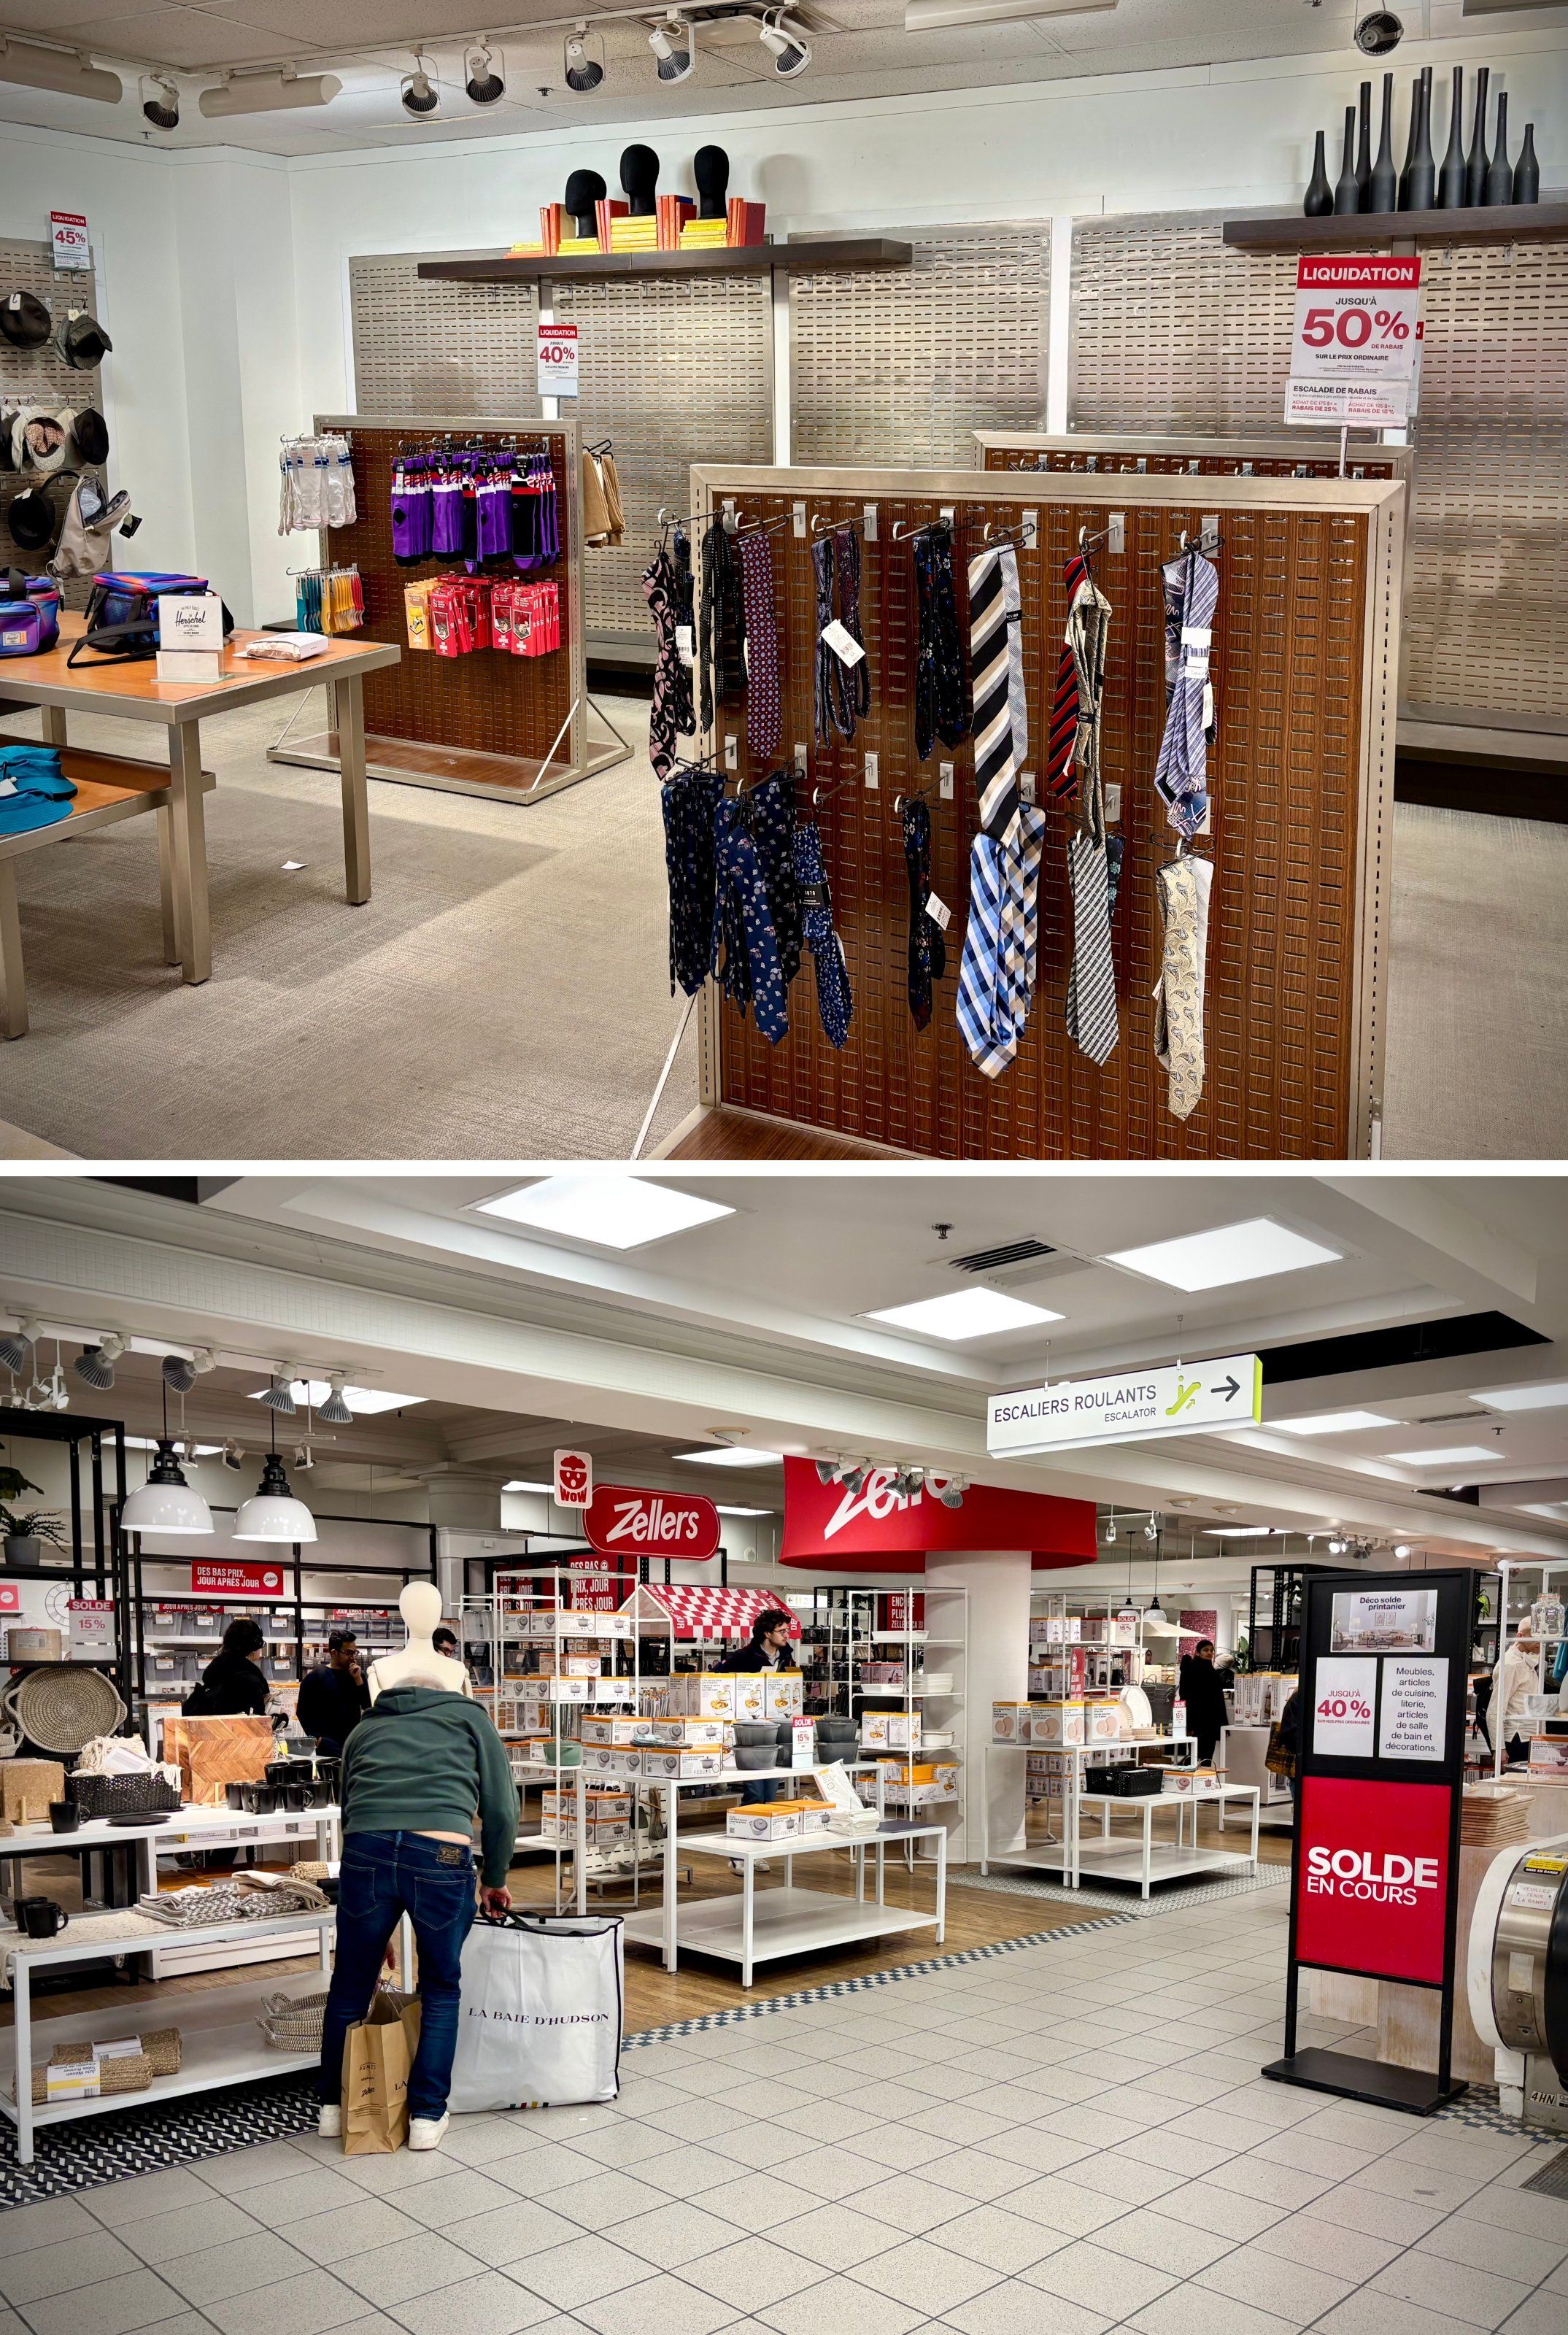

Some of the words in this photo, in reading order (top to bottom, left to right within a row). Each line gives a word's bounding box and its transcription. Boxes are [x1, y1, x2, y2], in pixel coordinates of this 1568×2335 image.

[53, 215, 85, 224] LIQUIDATION
[55, 230, 86, 244] 45%
[1303, 267, 1413, 281] LIQUIDATION
[1335, 296, 1378, 306] JUSQU'À
[1302, 308, 1410, 348] 50%
[539, 346, 575, 363] 40%
[1294, 385, 1335, 393] ESCALADE
[175, 610, 206, 628] Herschel
[995, 1397, 1070, 1423] ESCALIERS
[1075, 1385, 1156, 1411] ROULANTS
[1105, 1407, 1156, 1422] ESCALATOR
[560, 1483, 587, 1503] WOW
[606, 1499, 700, 1543] Zellers
[197, 1567, 211, 1575] DES
[212, 1567, 226, 1577] BAS
[228, 1569, 246, 1578] PRIX,
[197, 1577, 216, 1586] JOUR
[242, 1578, 259, 1588] JOUR
[590, 1578, 609, 1592] JOUR
[72, 1601, 111, 1610] SOLDE
[594, 1596, 614, 1610] JOUR
[1368, 1603, 1406, 1611] printanier
[79, 1619, 92, 1629] 15
[94, 1620, 105, 1629] %
[1396, 1667, 1434, 1676] Meubles,
[1328, 1689, 1361, 1697] JUSQU'À
[1405, 1690, 1437, 1698] cuisine,
[1317, 1699, 1347, 1718] 40
[1350, 1700, 1371, 1718] %
[1401, 1700, 1426, 1708] literie,
[795, 1718, 812, 1726] SOLDE
[797, 1734, 803, 1742] 15
[1404, 1732, 1422, 1740] bain
[1424, 1733, 1432, 1741] et
[1386, 1742, 1437, 1752] décorations.
[1307, 1846, 1439, 1889] SOLDE
[1307, 1875, 1334, 1895] EN
[1339, 1880, 1418, 1906] COURS
[468, 2007, 487, 2018] LA
[493, 2011, 530, 2023] BAIE
[535, 2012, 609, 2026] D'HUDSON
[395, 2080, 409, 2091] LA
[361, 2087, 375, 2097] Zellers
